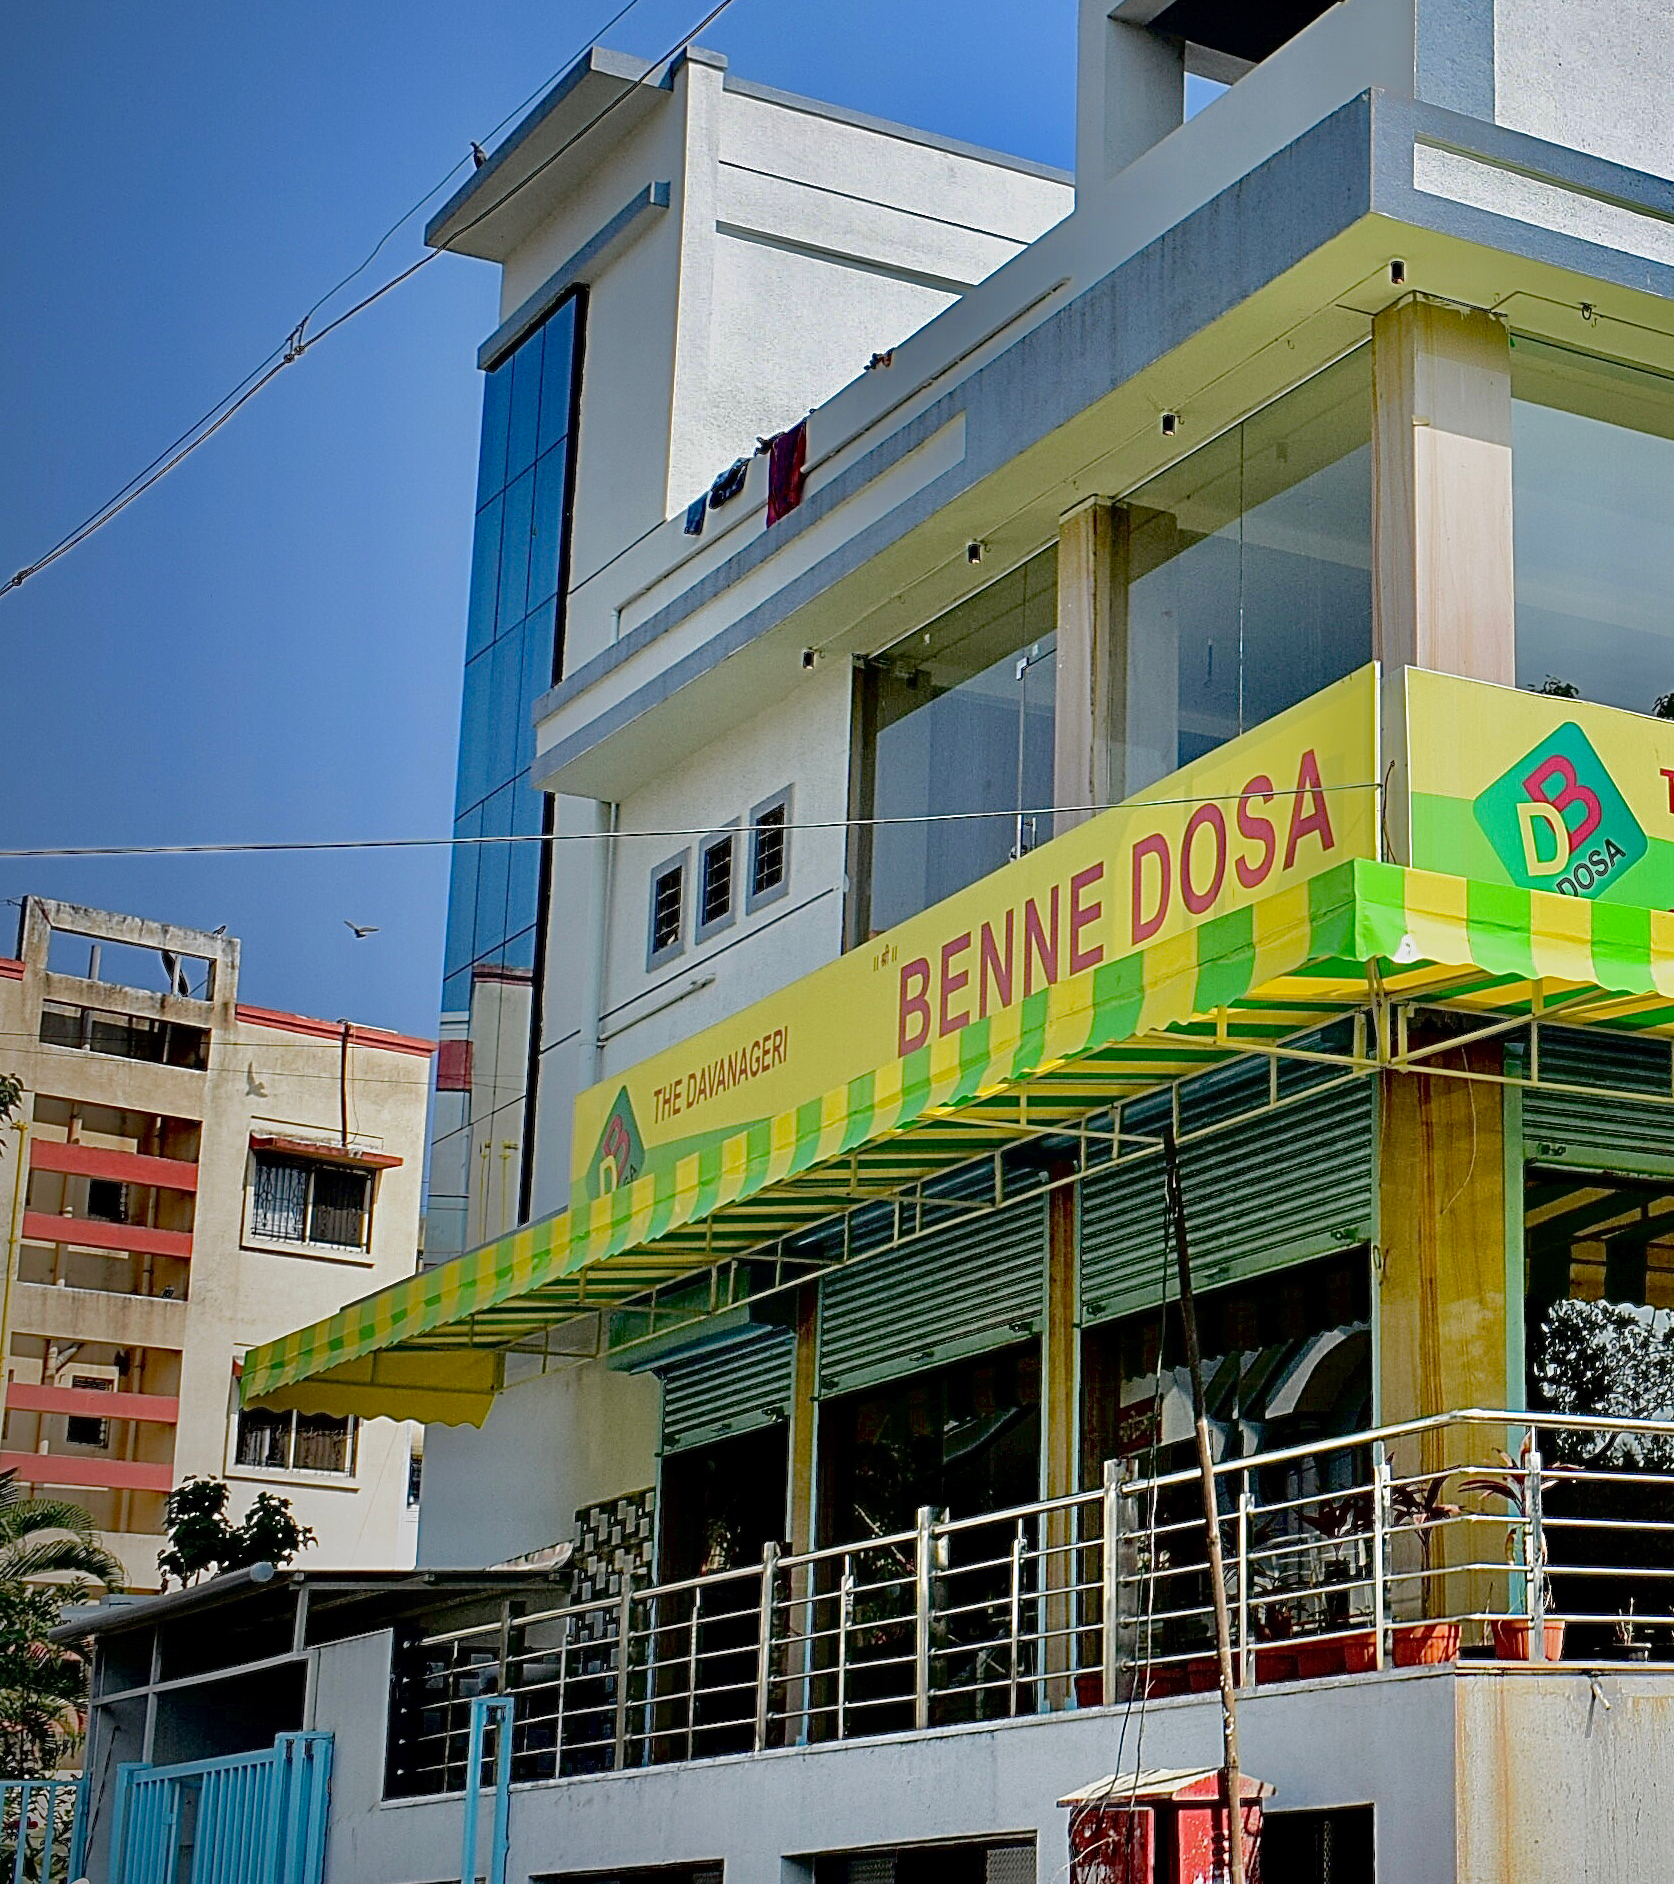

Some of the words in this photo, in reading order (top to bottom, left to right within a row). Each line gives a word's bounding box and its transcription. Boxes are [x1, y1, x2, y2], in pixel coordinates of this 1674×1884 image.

[897, 860, 1106, 1059] BENNE
[1131, 748, 1336, 946] DOSA
[1555, 838, 1627, 898] DOSA
[653, 1078, 683, 1124] THE
[686, 1025, 788, 1110] DAVANAGERI
